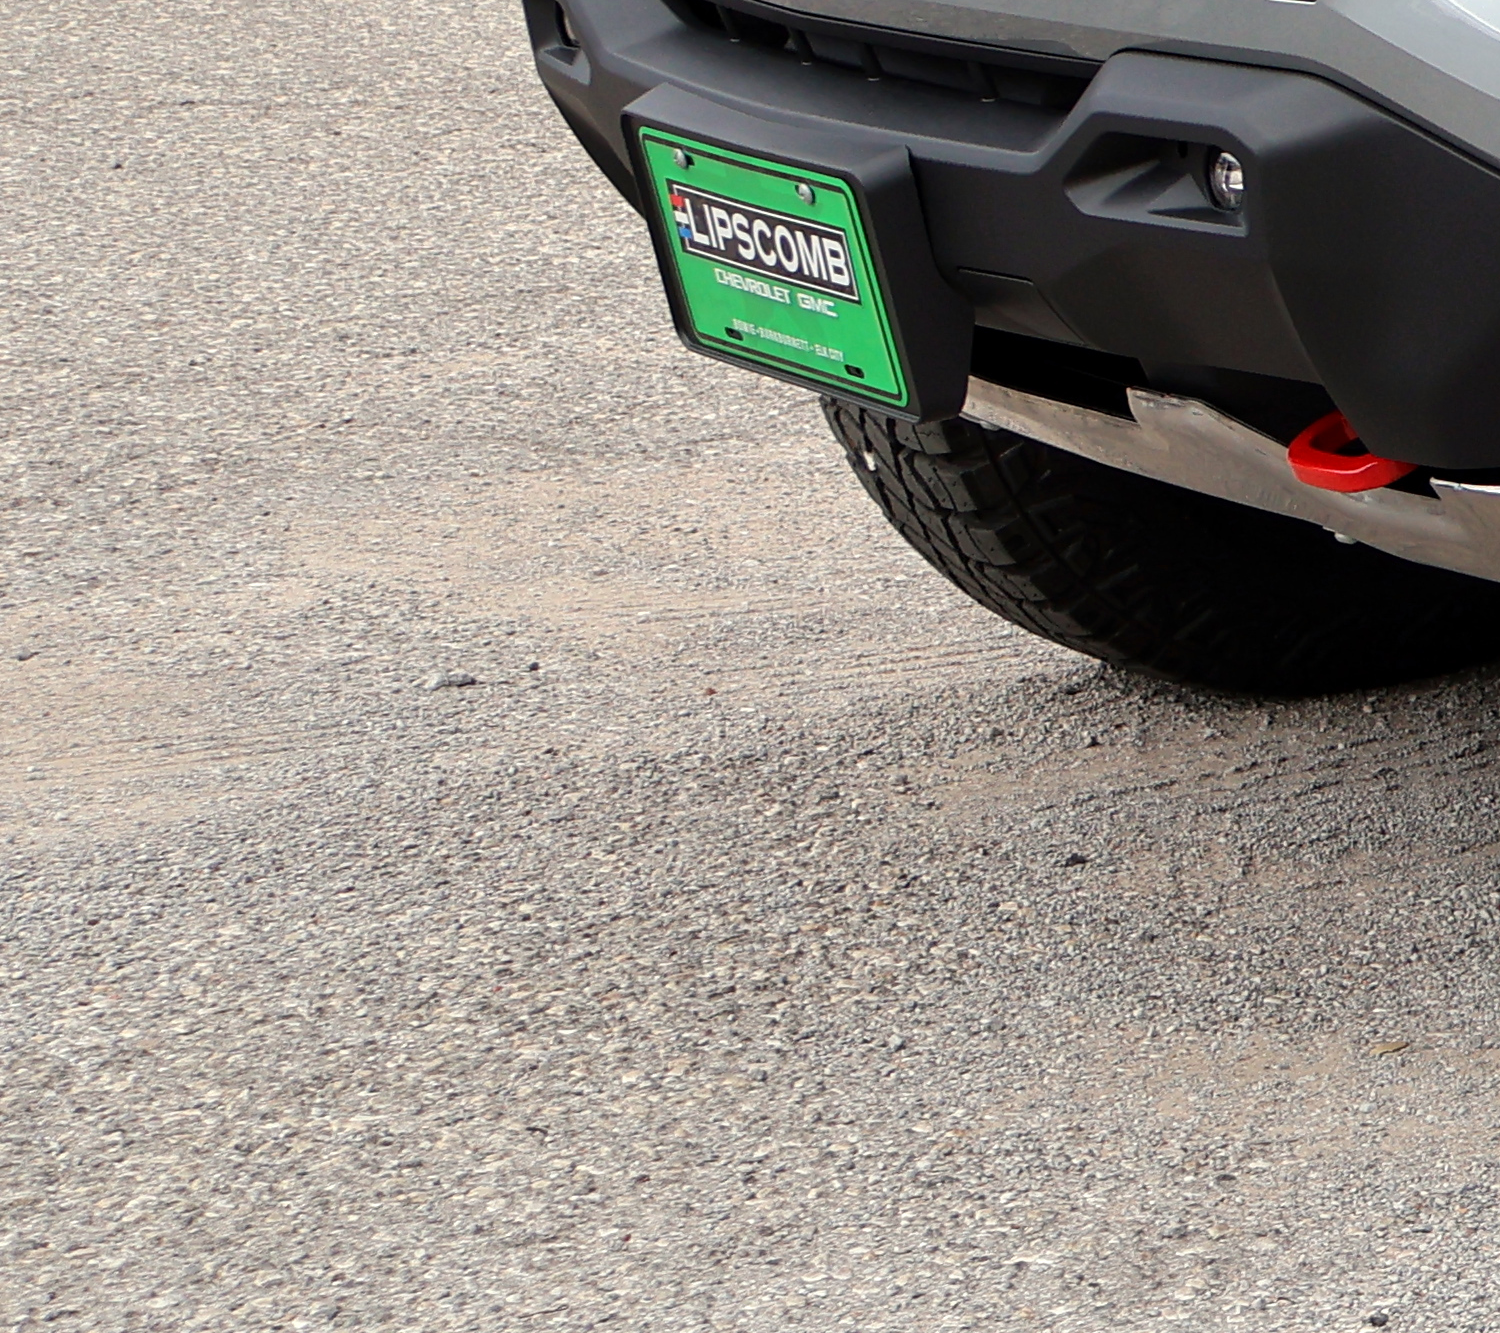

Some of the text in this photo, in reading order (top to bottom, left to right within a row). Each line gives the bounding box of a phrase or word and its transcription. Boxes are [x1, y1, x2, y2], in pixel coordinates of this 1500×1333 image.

[684, 197, 851, 287] LIPSCOMB
[713, 267, 838, 318] CHEVROLET GMC
